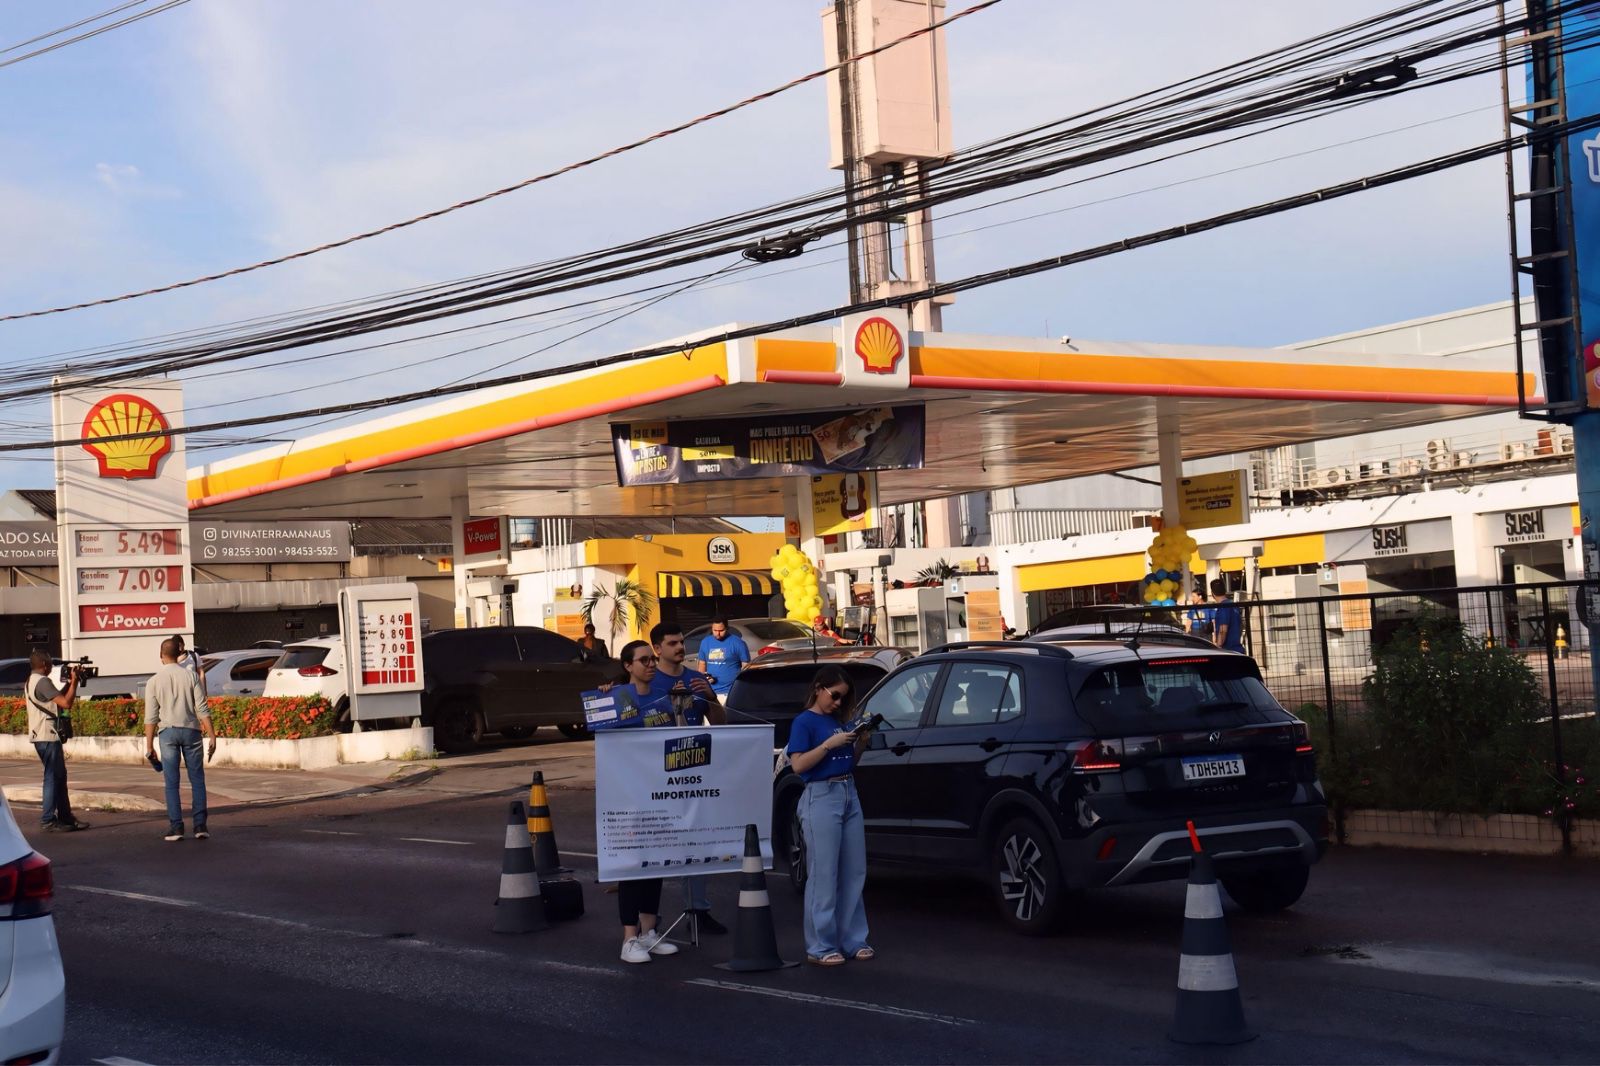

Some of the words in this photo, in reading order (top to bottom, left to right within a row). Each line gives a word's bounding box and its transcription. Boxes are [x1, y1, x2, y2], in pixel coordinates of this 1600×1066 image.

[750, 437, 814, 464] DINHEIRO
[697, 464, 720, 473] IMPOSTO
[789, 521, 798, 535] 3
[1505, 509, 1544, 536] SUSHI
[79, 533, 100, 542] Etanol
[221, 528, 331, 539] DIVINATERRAMANAUS
[468, 532, 497, 543] V-Power
[1372, 525, 1407, 549] SUSHI
[118, 532, 163, 553] 5.49
[11, 550, 35, 558] TODA
[222, 547, 277, 556] 98255-3001
[284, 546, 338, 556] 98453-5525
[712, 544, 731, 554] JSK
[80, 571, 109, 579] Gasolina
[118, 568, 166, 591] 7.09
[96, 615, 166, 629] V-Power
[677, 737, 695, 751] LIVRE
[666, 748, 706, 769] IMPOSTOS
[1189, 761, 1239, 777] TDH5H13
[667, 776, 702, 785] AVISOS
[652, 789, 720, 800] IMPORTANTES
